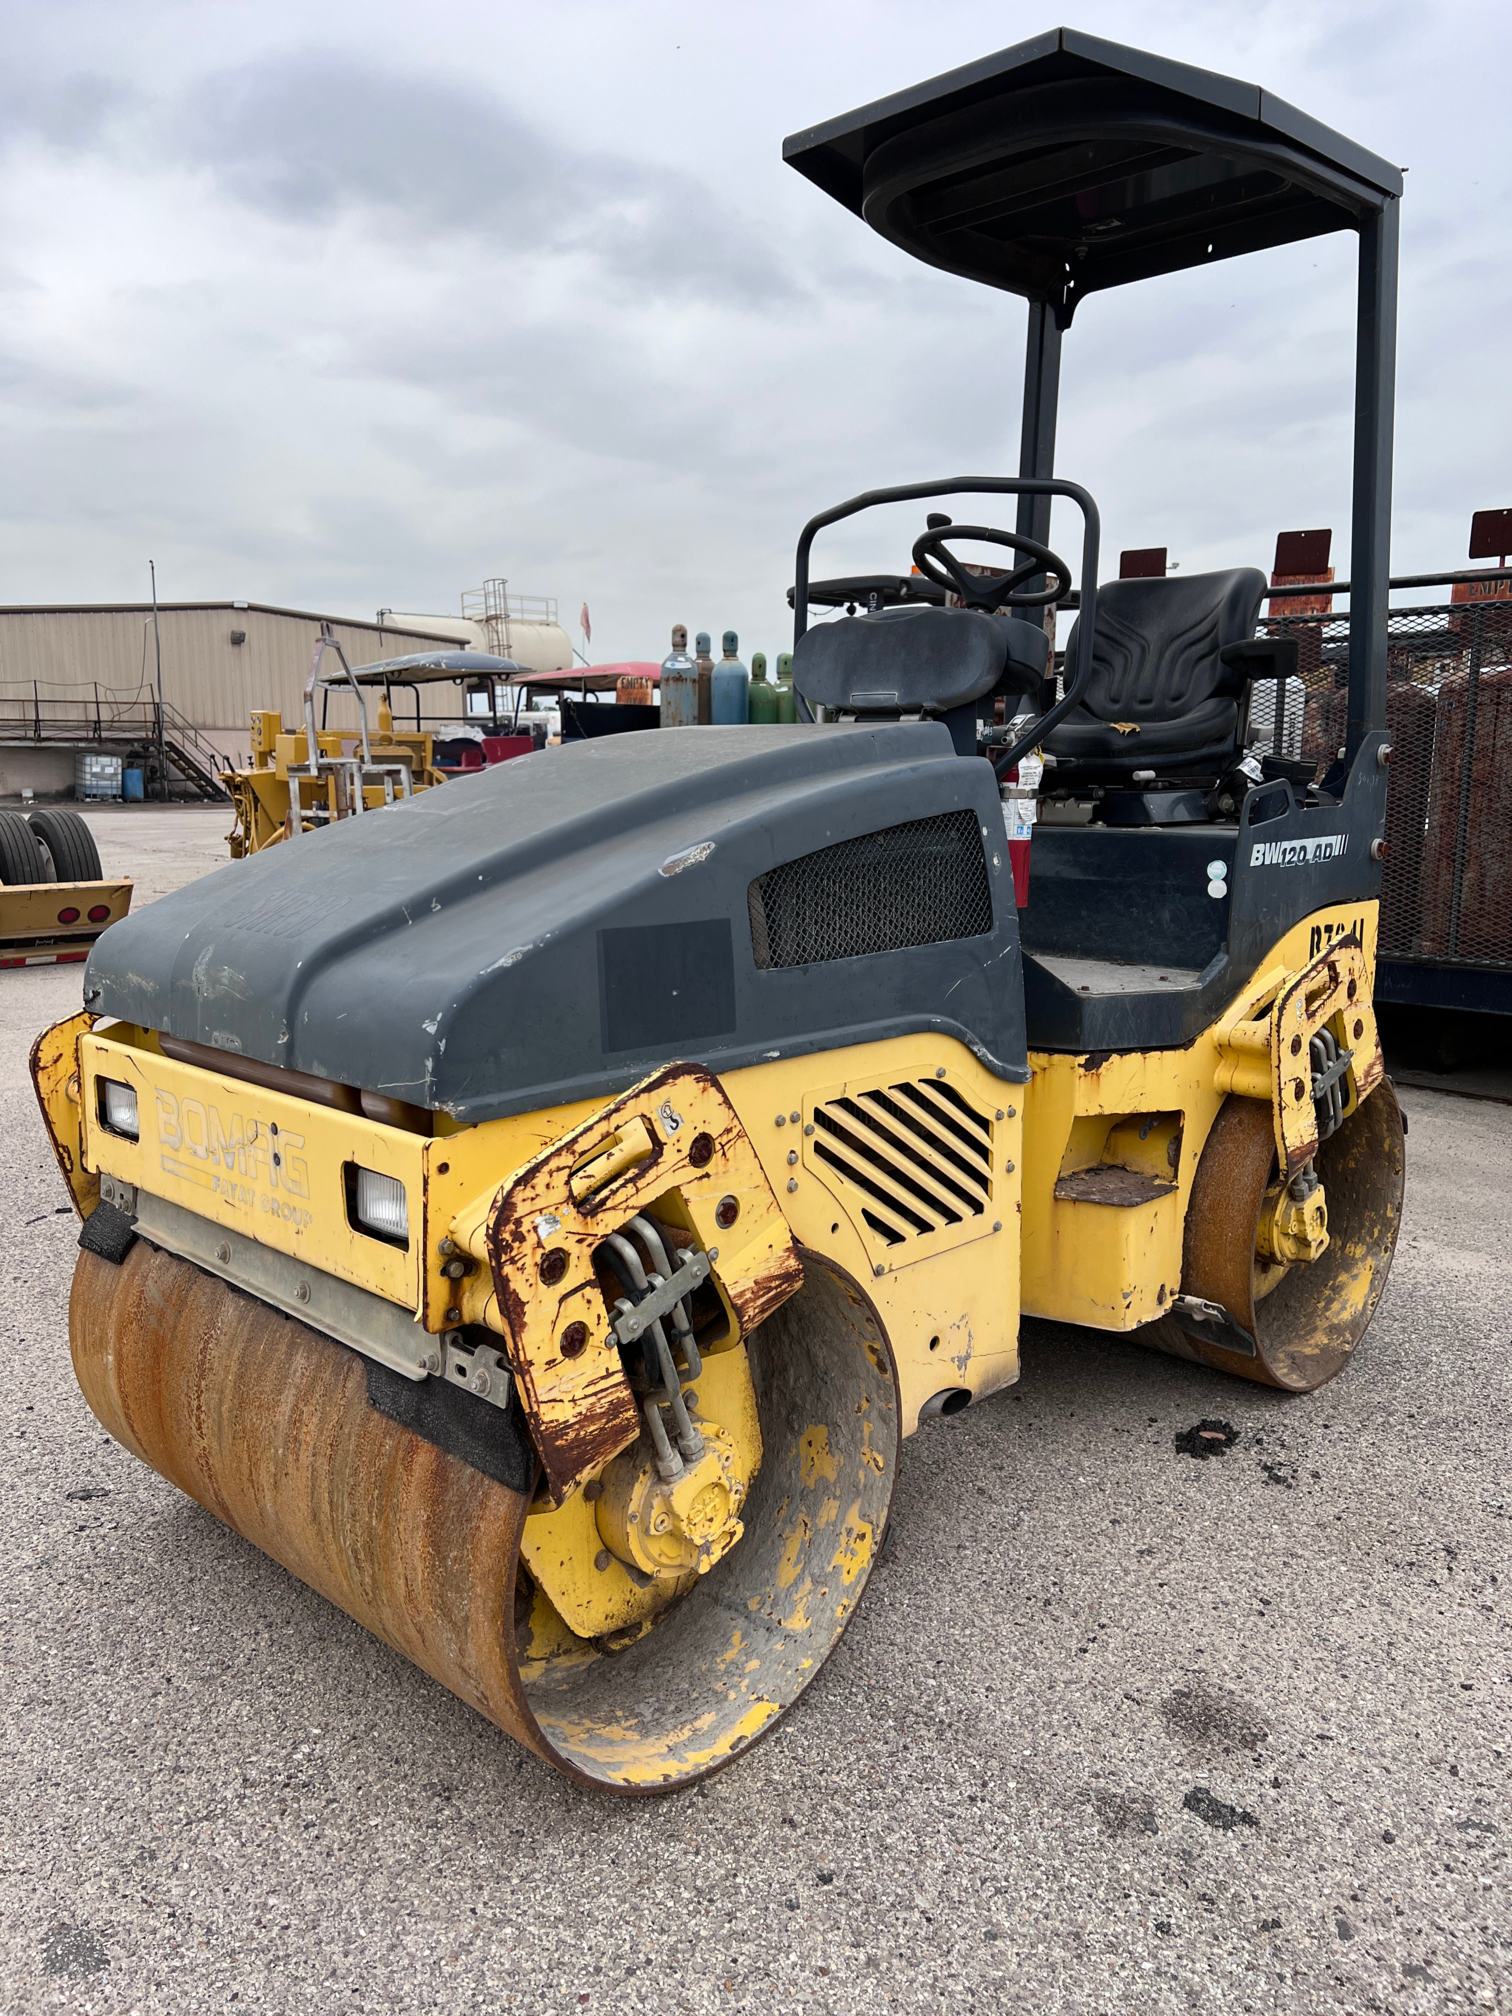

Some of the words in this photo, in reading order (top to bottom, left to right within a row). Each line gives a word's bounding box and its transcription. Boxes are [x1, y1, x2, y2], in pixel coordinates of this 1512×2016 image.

[621, 677, 650, 690] EMPTY
[155, 1088, 310, 1200] BOMAG
[213, 1175, 256, 1207] FAYAT
